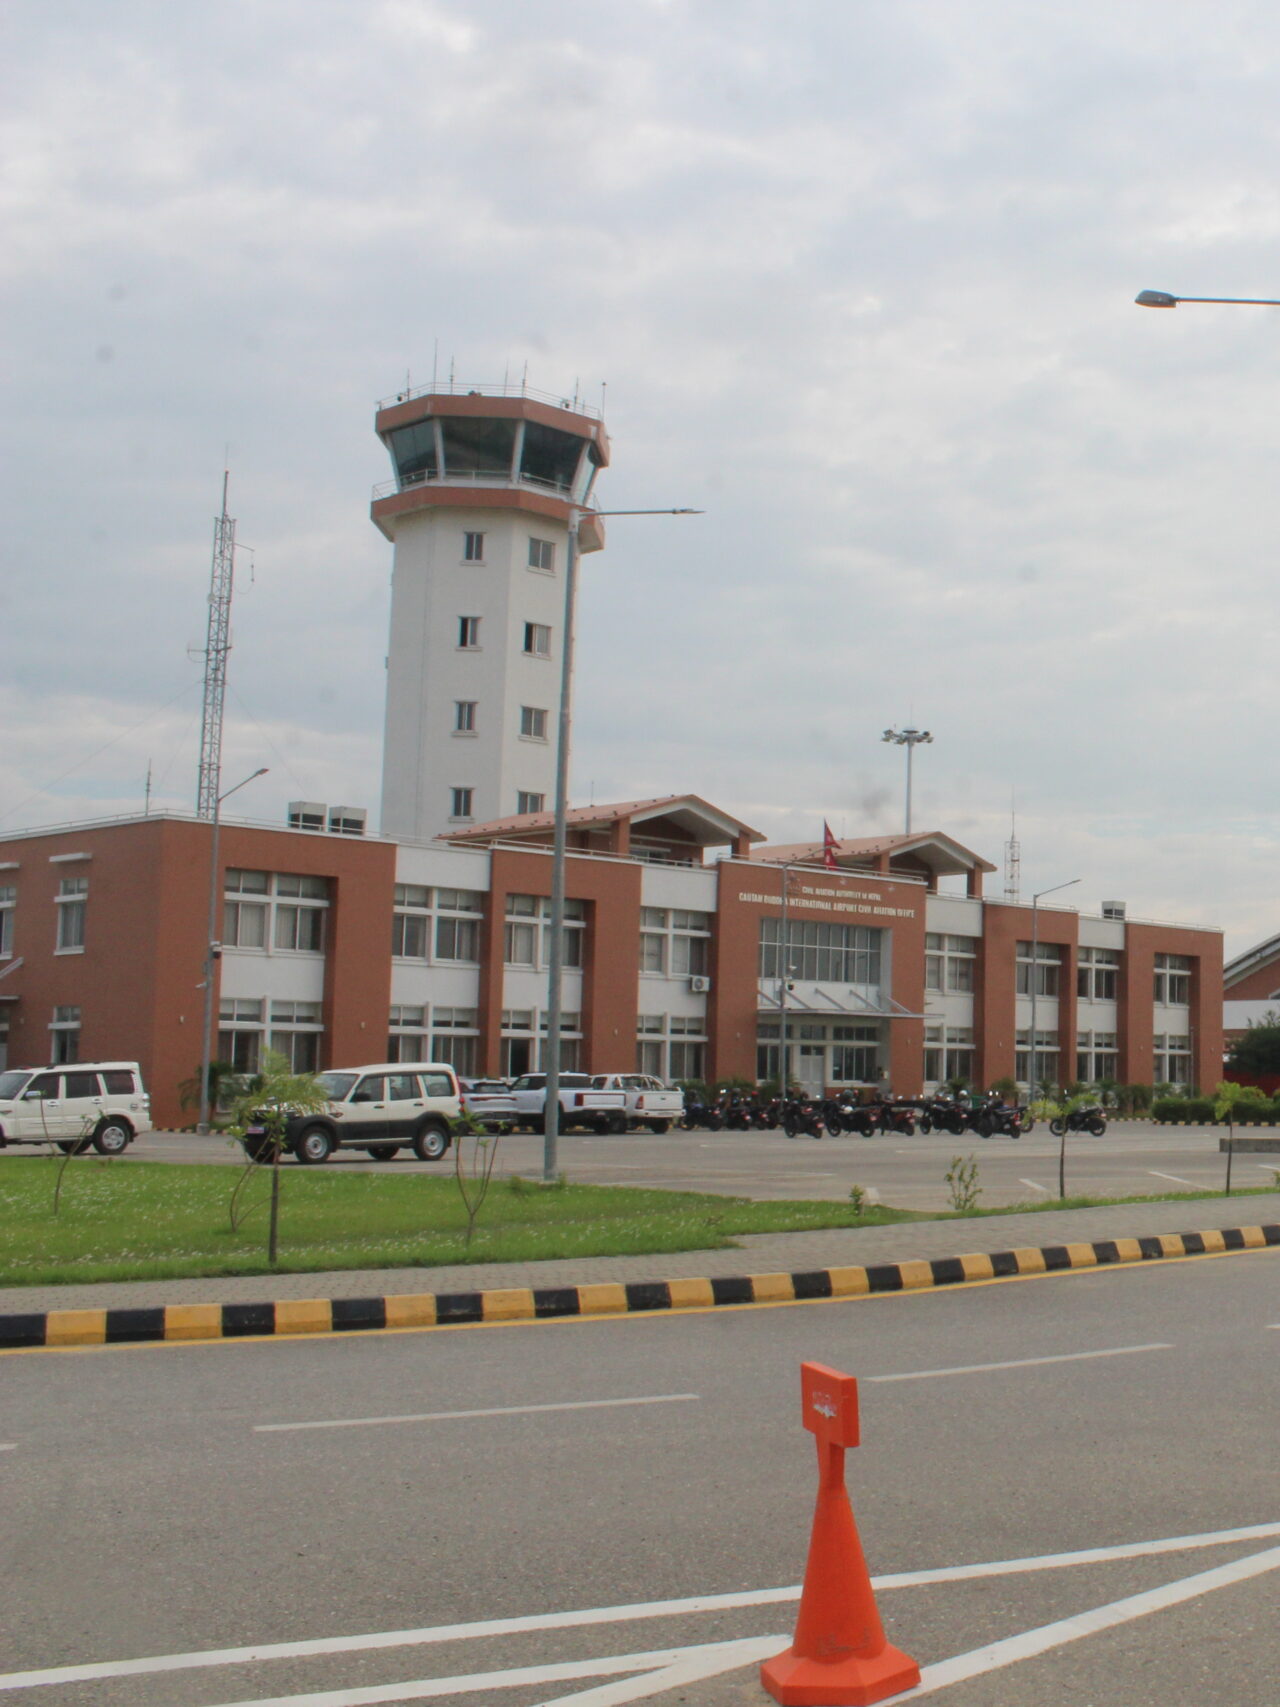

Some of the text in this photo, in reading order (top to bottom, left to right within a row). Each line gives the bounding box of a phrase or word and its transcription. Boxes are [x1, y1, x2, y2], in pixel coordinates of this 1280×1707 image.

[789, 897, 832, 911] INTERNATIONAL
[833, 902, 857, 913] AIRPORT
[858, 904, 872, 914] CIVIL
[873, 906, 896, 917] AVIATION
[897, 908, 915, 919] OFFICE
